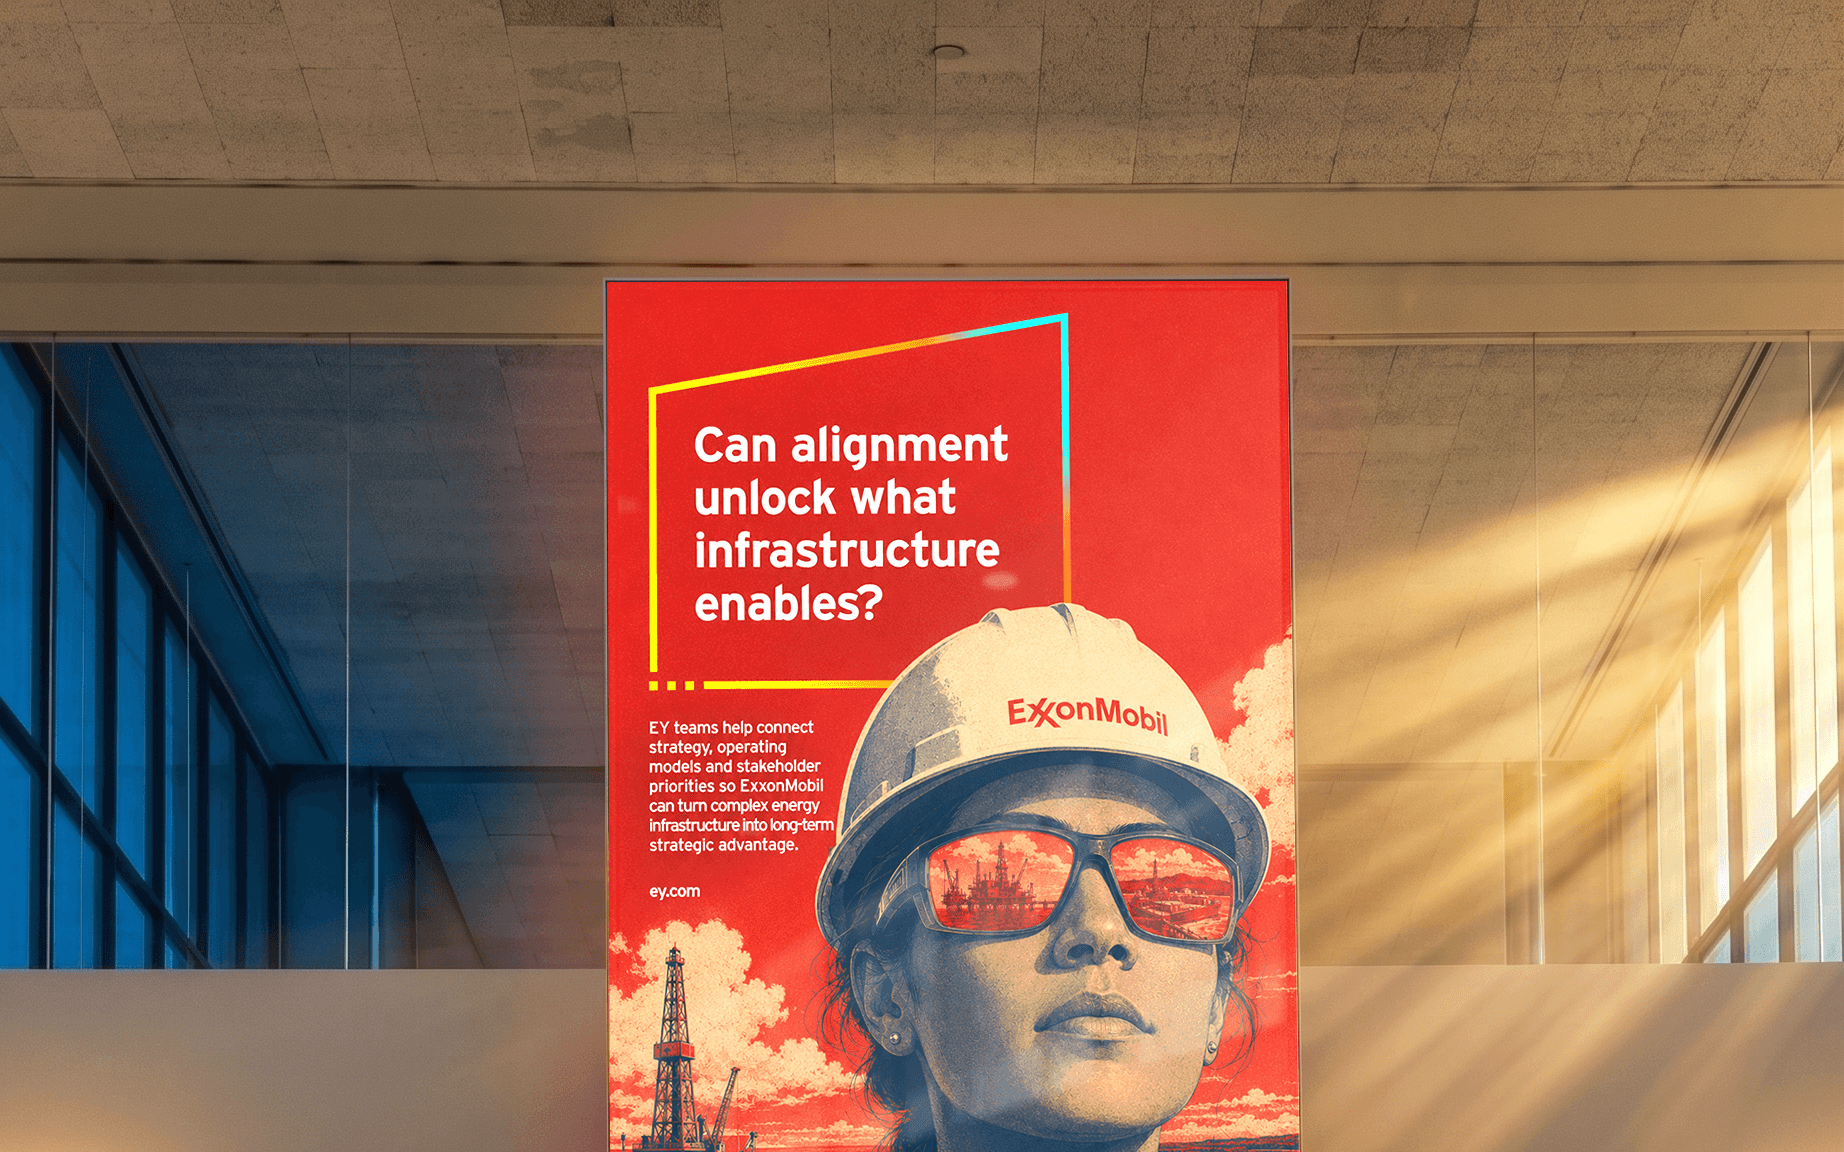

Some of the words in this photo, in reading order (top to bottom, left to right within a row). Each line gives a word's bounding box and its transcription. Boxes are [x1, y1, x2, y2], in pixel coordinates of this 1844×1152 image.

[694, 427, 776, 463] Can
[791, 425, 1009, 471] alignment
[695, 478, 837, 516] unlock
[850, 478, 956, 515] what
[695, 531, 1000, 569] infrastructure
[695, 584, 883, 622] enables?
[1007, 697, 1169, 737] ExxonMobil
[649, 721, 670, 735] EY
[674, 721, 719, 735] teams
[722, 721, 753, 737] help
[756, 720, 814, 734] connect
[649, 740, 713, 757] strategy,
[717, 739, 787, 757] operating
[649, 760, 702, 774] models
[705, 760, 733, 773] and
[736, 759, 822, 773] stakeholder
[649, 779, 715, 796] priorities
[719, 782, 736, 793] so
[740, 779, 824, 793] ExxonMobil
[649, 802, 675, 813] can
[677, 799, 708, 813] turn
[710, 799, 769, 815] complex
[771, 801, 821, 815] energy
[649, 818, 741, 832] infrastructure
[742, 818, 768, 832] into
[770, 817, 835, 835] long-term
[649, 838, 714, 854] strategic
[718, 838, 799, 855] advantage.
[649, 885, 701, 901] ey.com
